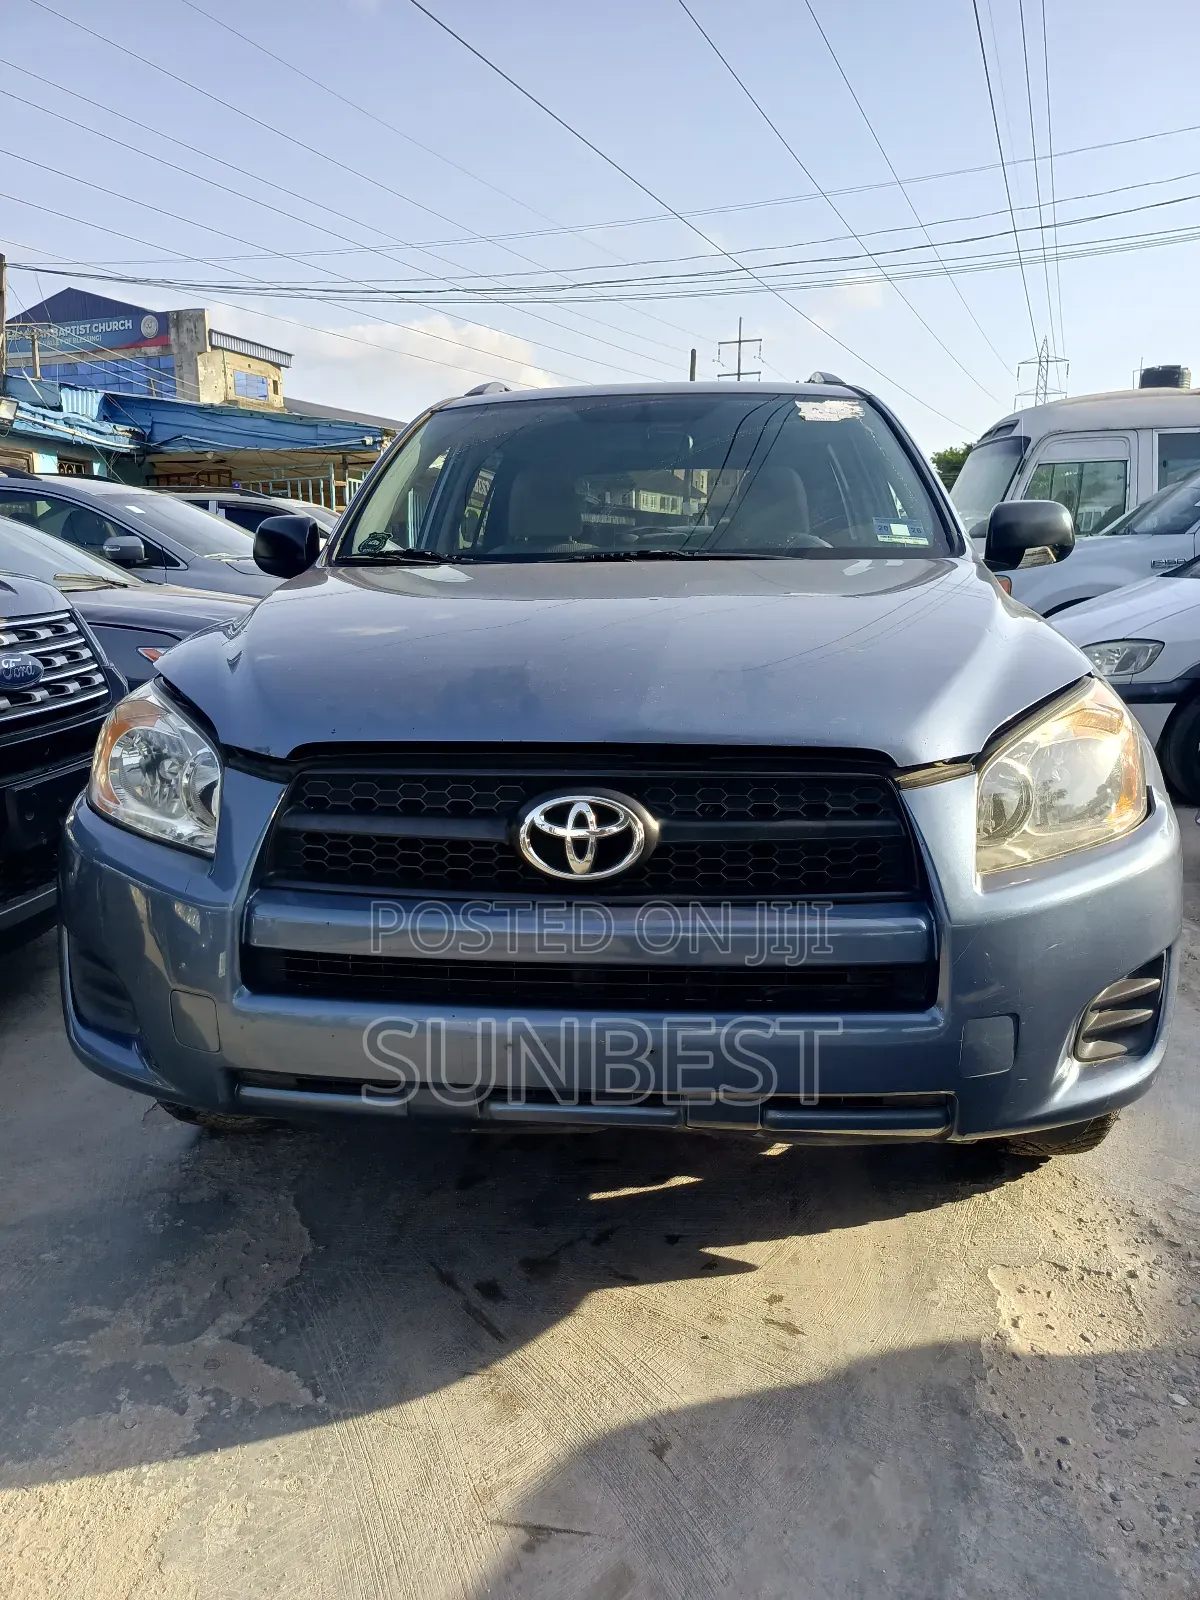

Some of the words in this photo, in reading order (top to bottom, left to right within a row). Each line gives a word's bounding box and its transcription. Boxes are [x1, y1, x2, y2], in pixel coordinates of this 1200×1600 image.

[52, 323, 91, 338] BAPTIST
[92, 319, 133, 333] CHURCH
[1, 657, 35, 680] Ford
